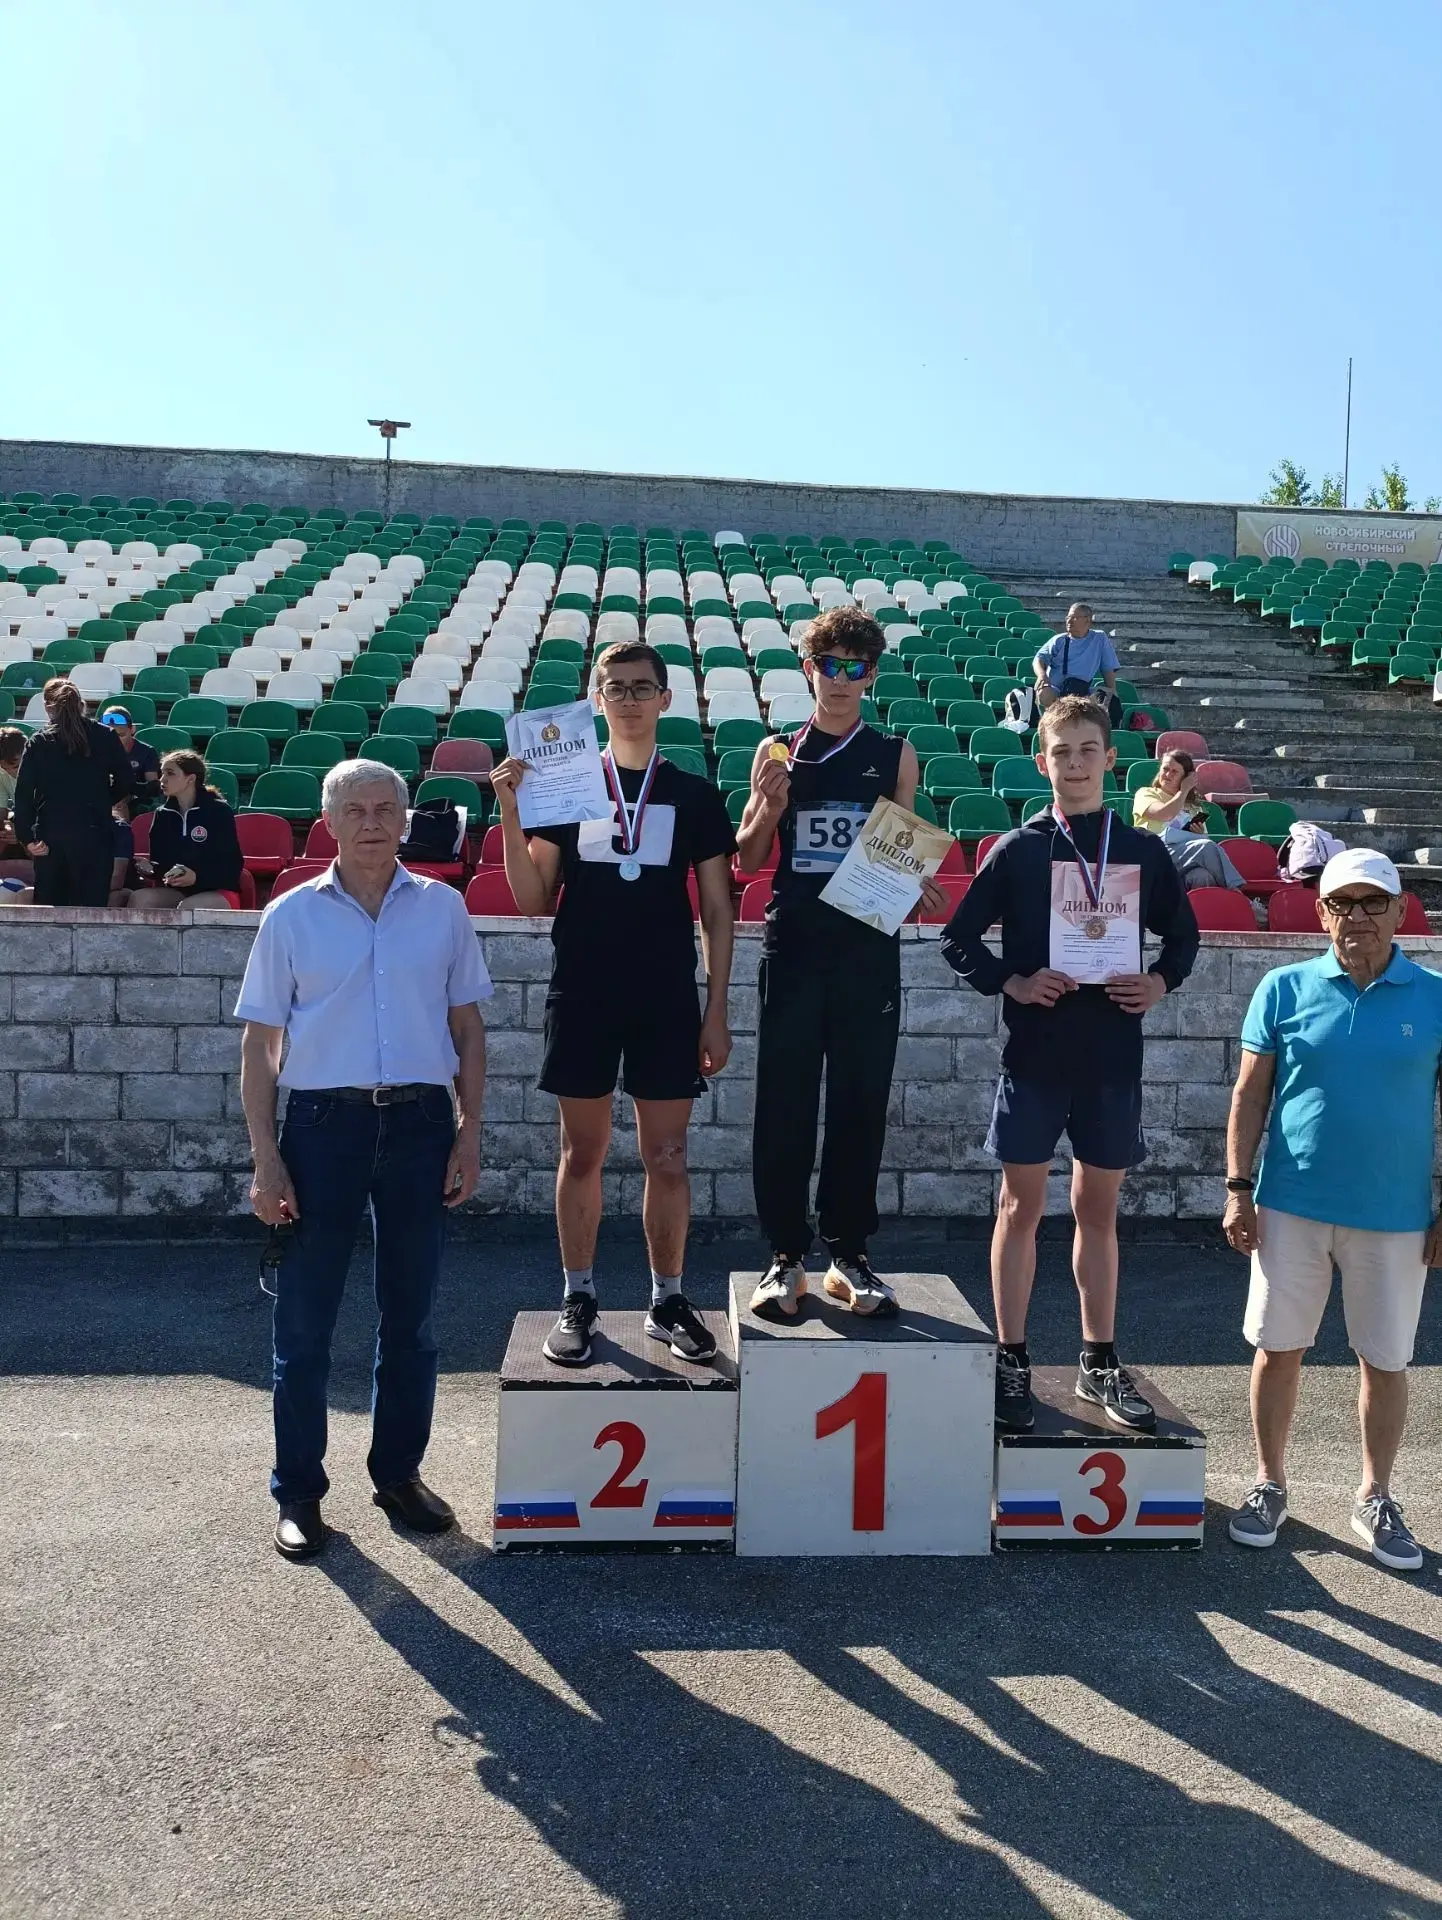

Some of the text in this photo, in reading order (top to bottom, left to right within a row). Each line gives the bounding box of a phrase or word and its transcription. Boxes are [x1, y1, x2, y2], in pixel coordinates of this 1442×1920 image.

[1315, 526, 1416, 541] НОВОСИБИРСКИЙ
[1325, 542, 1406, 554] СТРЕЛОЧНЫЙ
[523, 738, 587, 761] ДИПЛОМ
[808, 817, 868, 848] 58
[865, 834, 927, 874] ДИПЛОМ
[590, 1421, 649, 1508] 2
[815, 1373, 887, 1531] 1
[1073, 1452, 1127, 1535] 3
